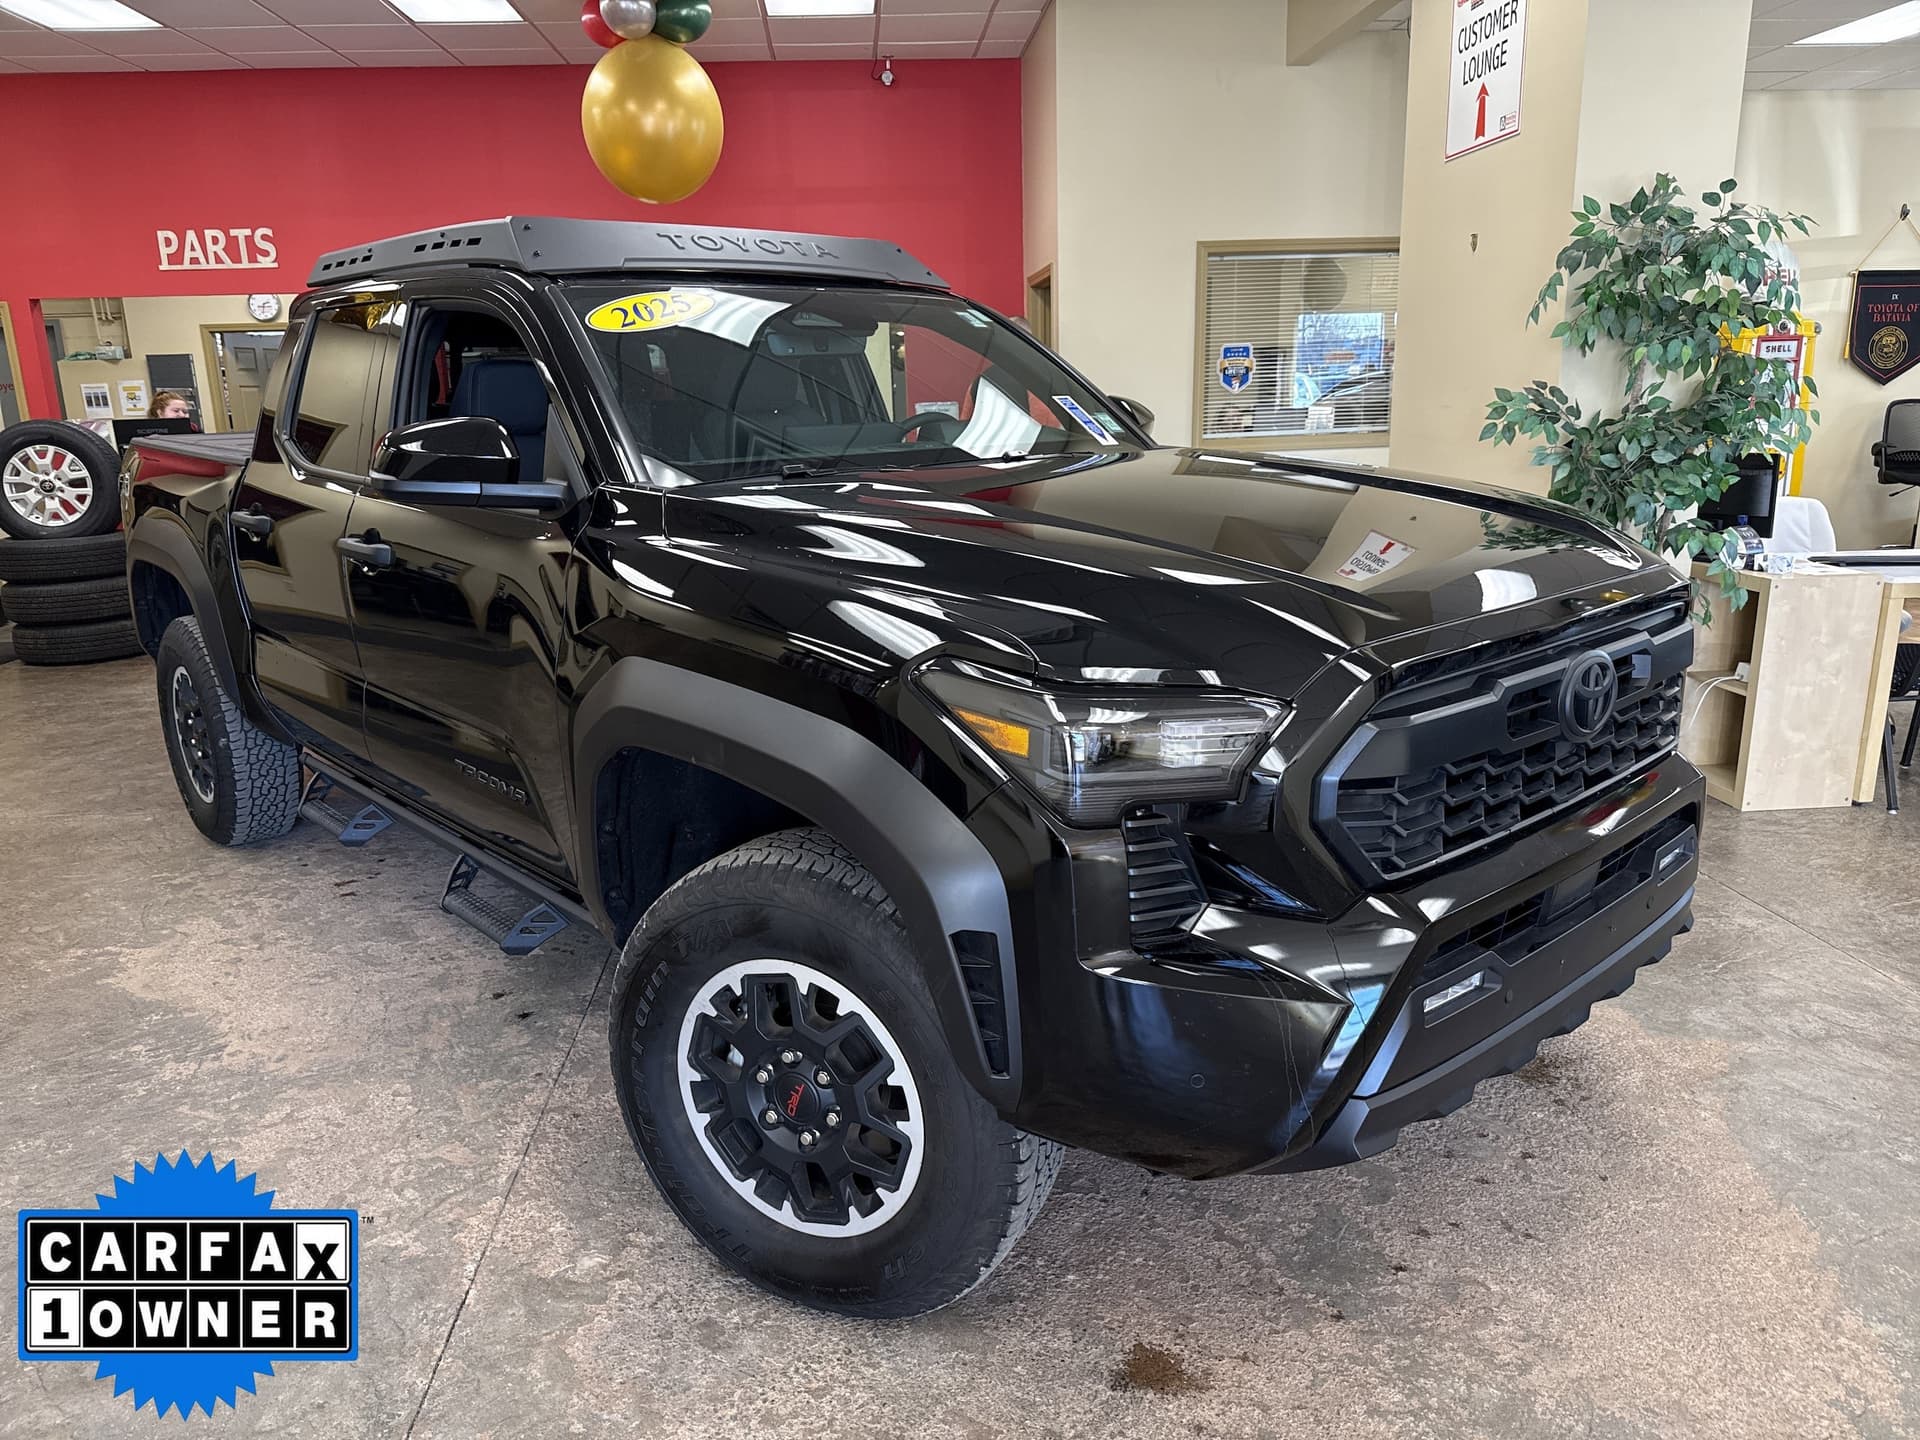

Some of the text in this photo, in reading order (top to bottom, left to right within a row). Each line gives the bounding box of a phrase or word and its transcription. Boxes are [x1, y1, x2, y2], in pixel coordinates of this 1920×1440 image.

[1458, 0, 1519, 54] CUSTOMER
[1463, 38, 1508, 86] LOUNGE
[156, 227, 278, 268] PARTS
[656, 232, 840, 259] TOYOTA
[611, 294, 692, 329] 2025
[1867, 303, 1920, 313] TOYOTA OF
[1872, 312, 1911, 323] BATAVIA
[1765, 345, 1792, 353] SHELL
[454, 758, 528, 806] TACOMA
[786, 1083, 805, 1118] TRD
